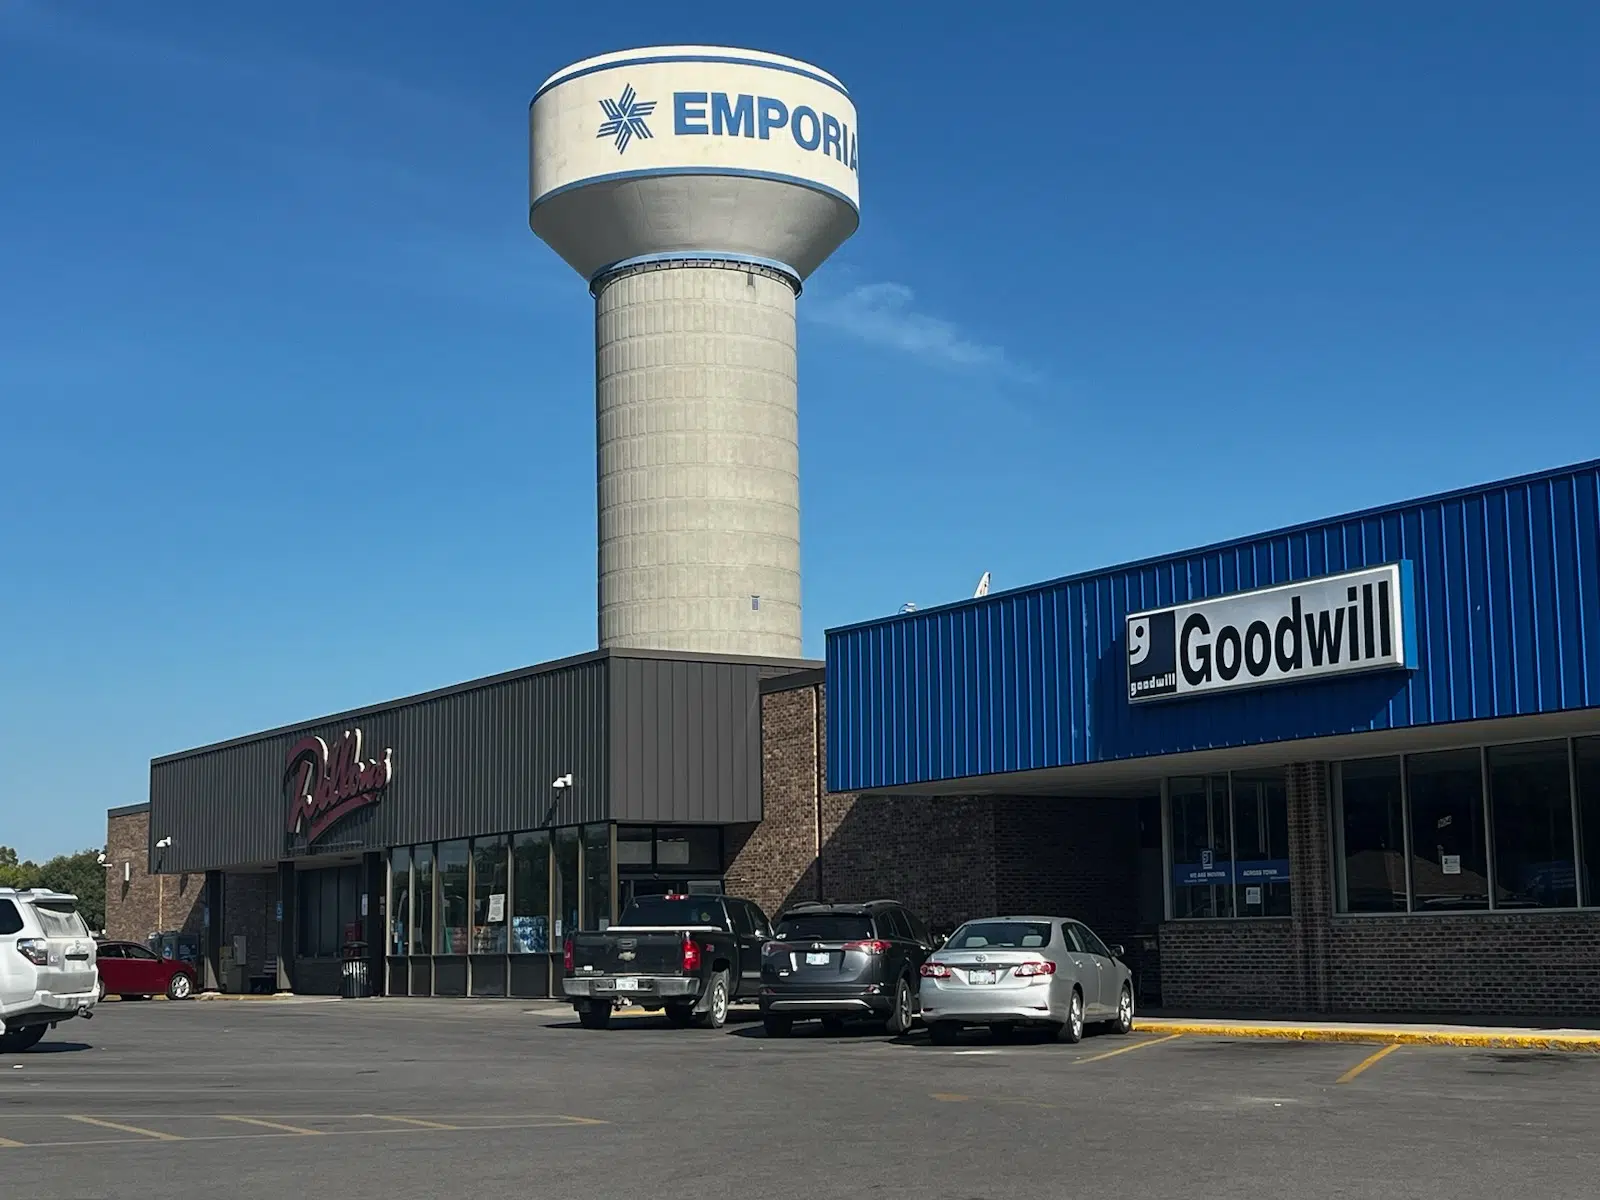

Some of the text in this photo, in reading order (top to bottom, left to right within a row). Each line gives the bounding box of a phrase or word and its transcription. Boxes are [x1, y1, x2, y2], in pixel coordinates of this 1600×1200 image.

[673, 92, 857, 171] EMPORIA
[1180, 580, 1391, 686] Goodwill
[1131, 673, 1175, 696] goodwill
